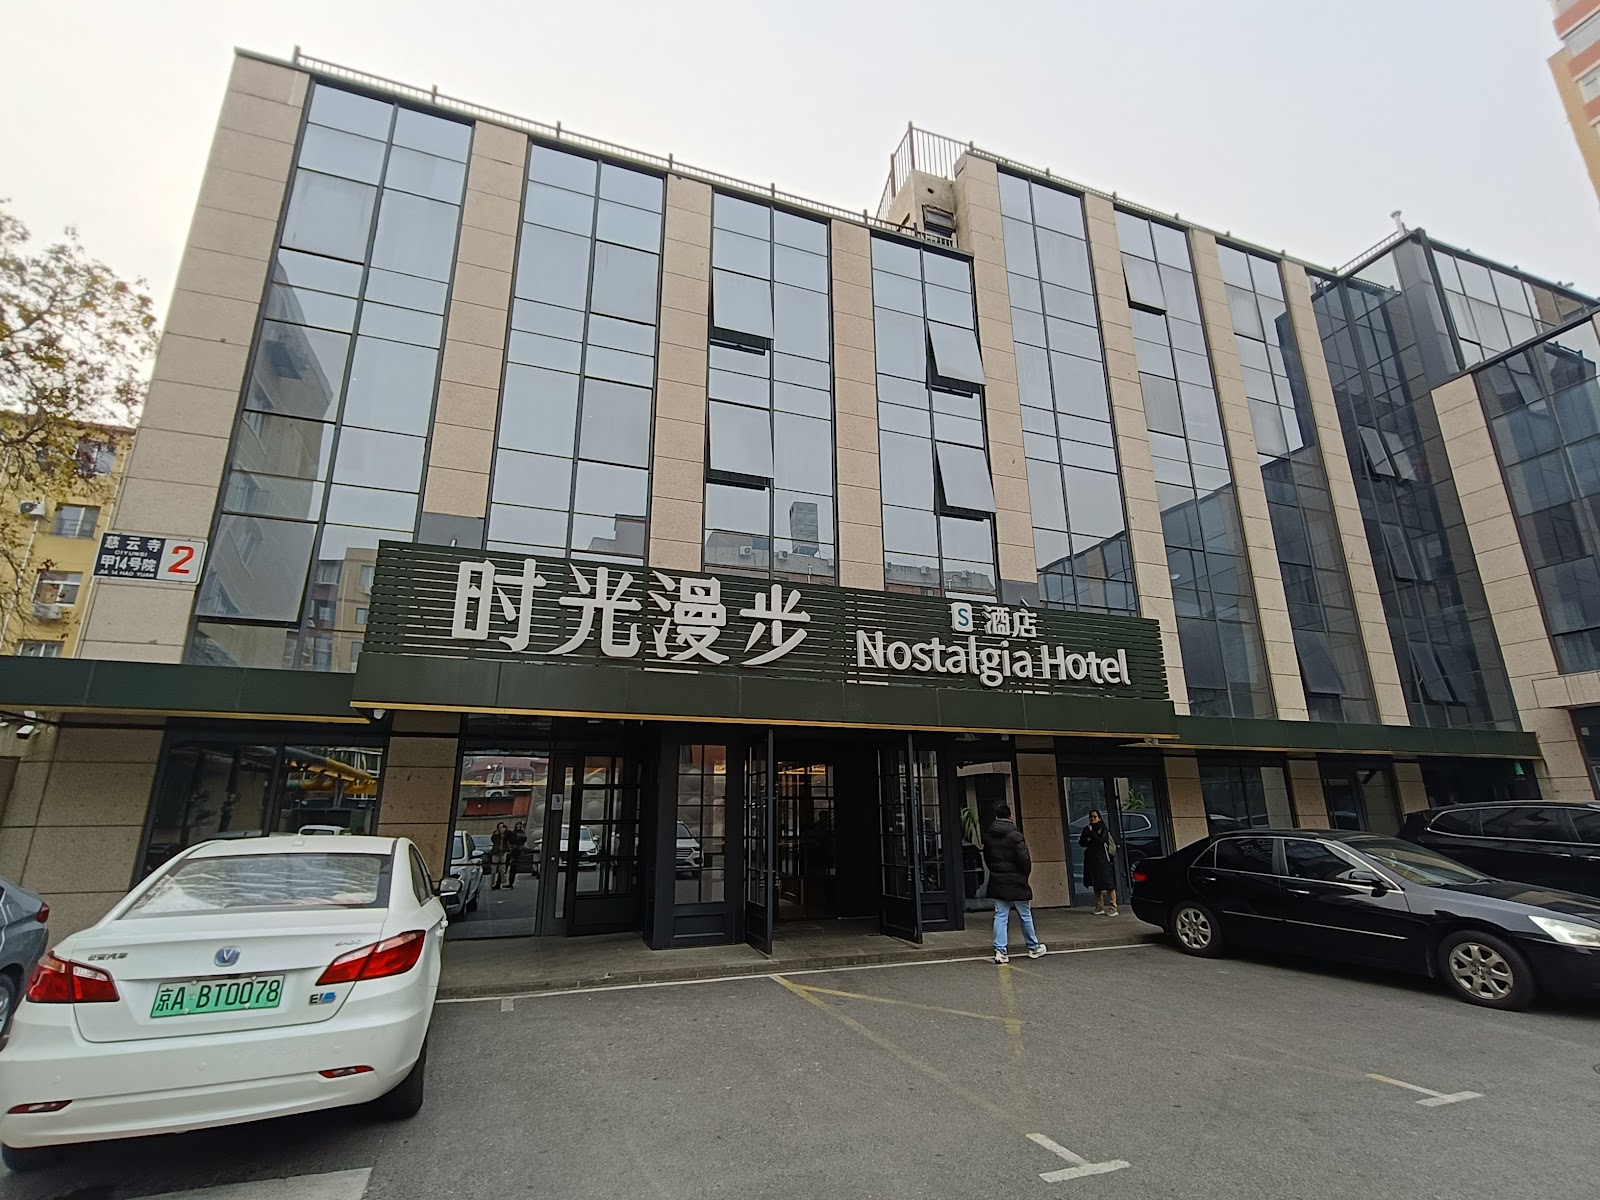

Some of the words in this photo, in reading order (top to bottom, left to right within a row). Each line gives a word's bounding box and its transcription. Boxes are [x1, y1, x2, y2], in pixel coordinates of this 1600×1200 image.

[104, 535, 162, 552] 慈云寺
[167, 545, 195, 574] 2
[100, 554, 157, 572] 甲14号院
[451, 558, 811, 666] 时光漫步
[981, 597, 1038, 638] 酒店
[856, 629, 1033, 688] Nostalgia
[1040, 644, 1132, 685] Hotel
[155, 986, 186, 1011] 京A
[195, 979, 281, 1009] BT0078
